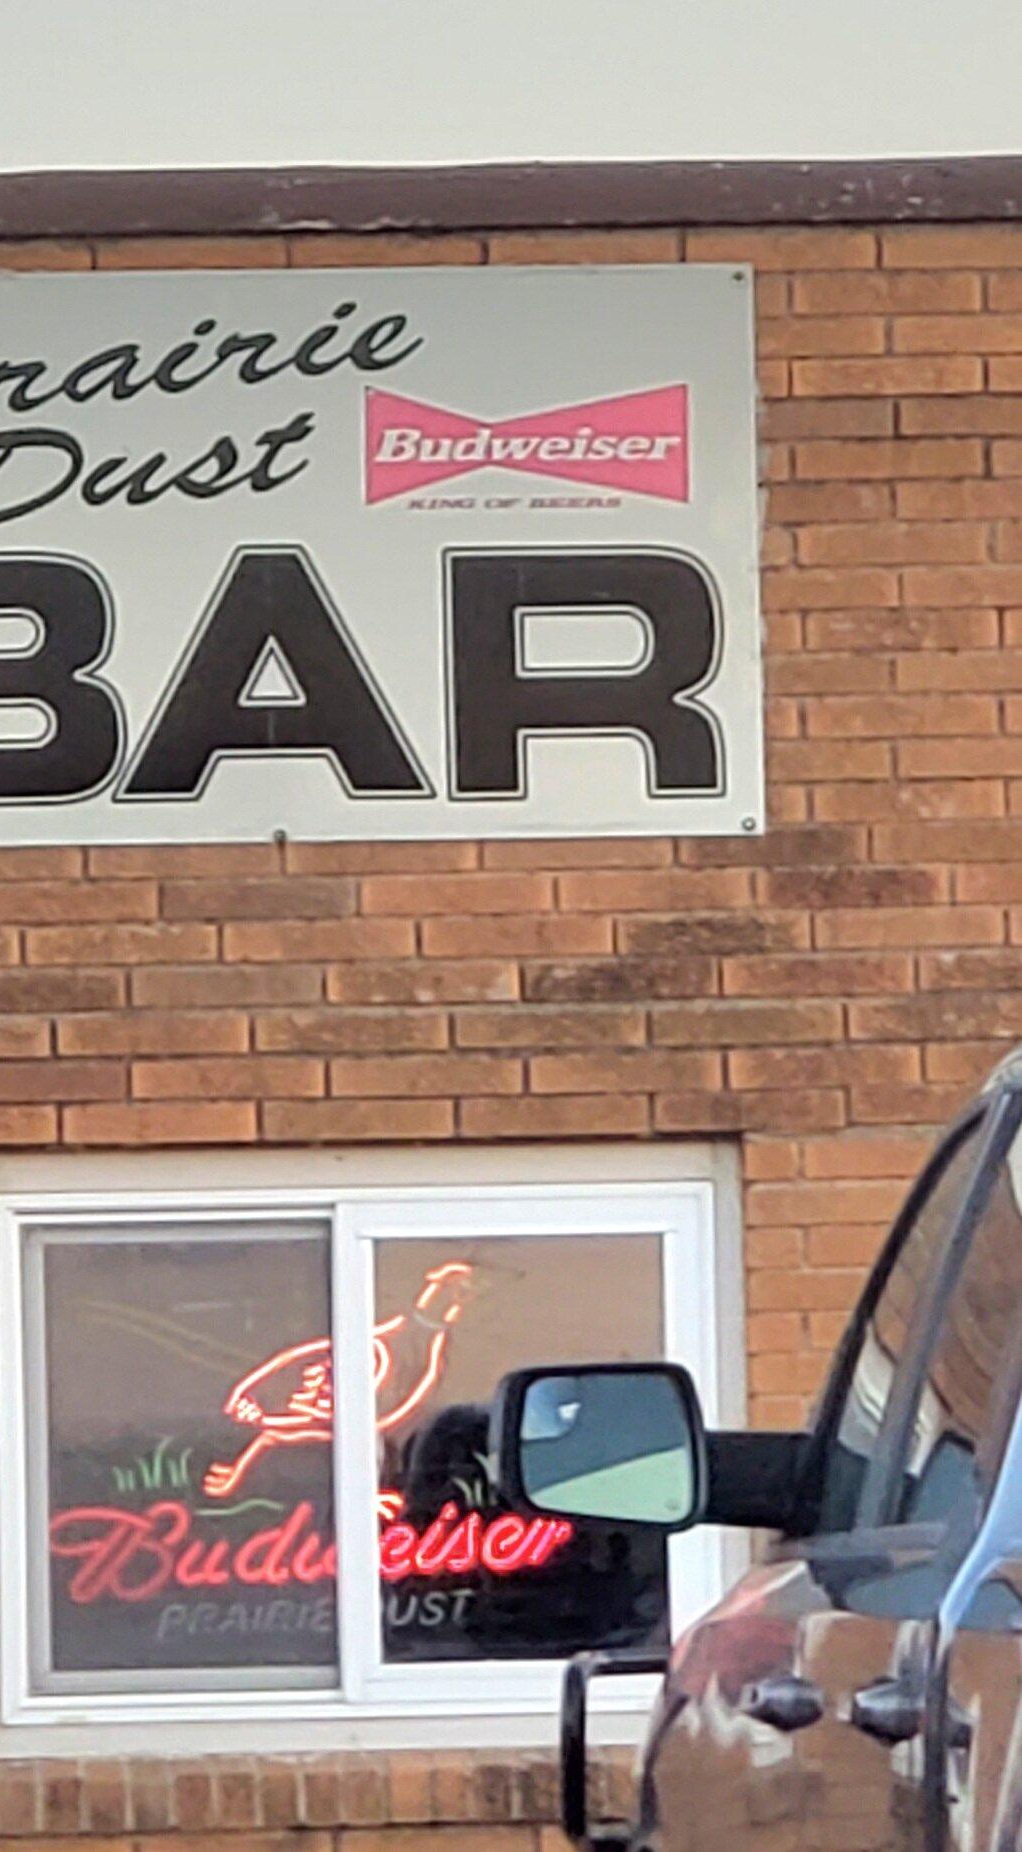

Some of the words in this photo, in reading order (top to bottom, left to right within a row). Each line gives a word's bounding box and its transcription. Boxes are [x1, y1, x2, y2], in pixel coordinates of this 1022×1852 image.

[374, 427, 683, 464] Budweiser
[408, 497, 477, 511] KING
[484, 497, 522, 510] OF
[529, 497, 622, 510] BEERS
[381, 1588, 475, 1627] UST
